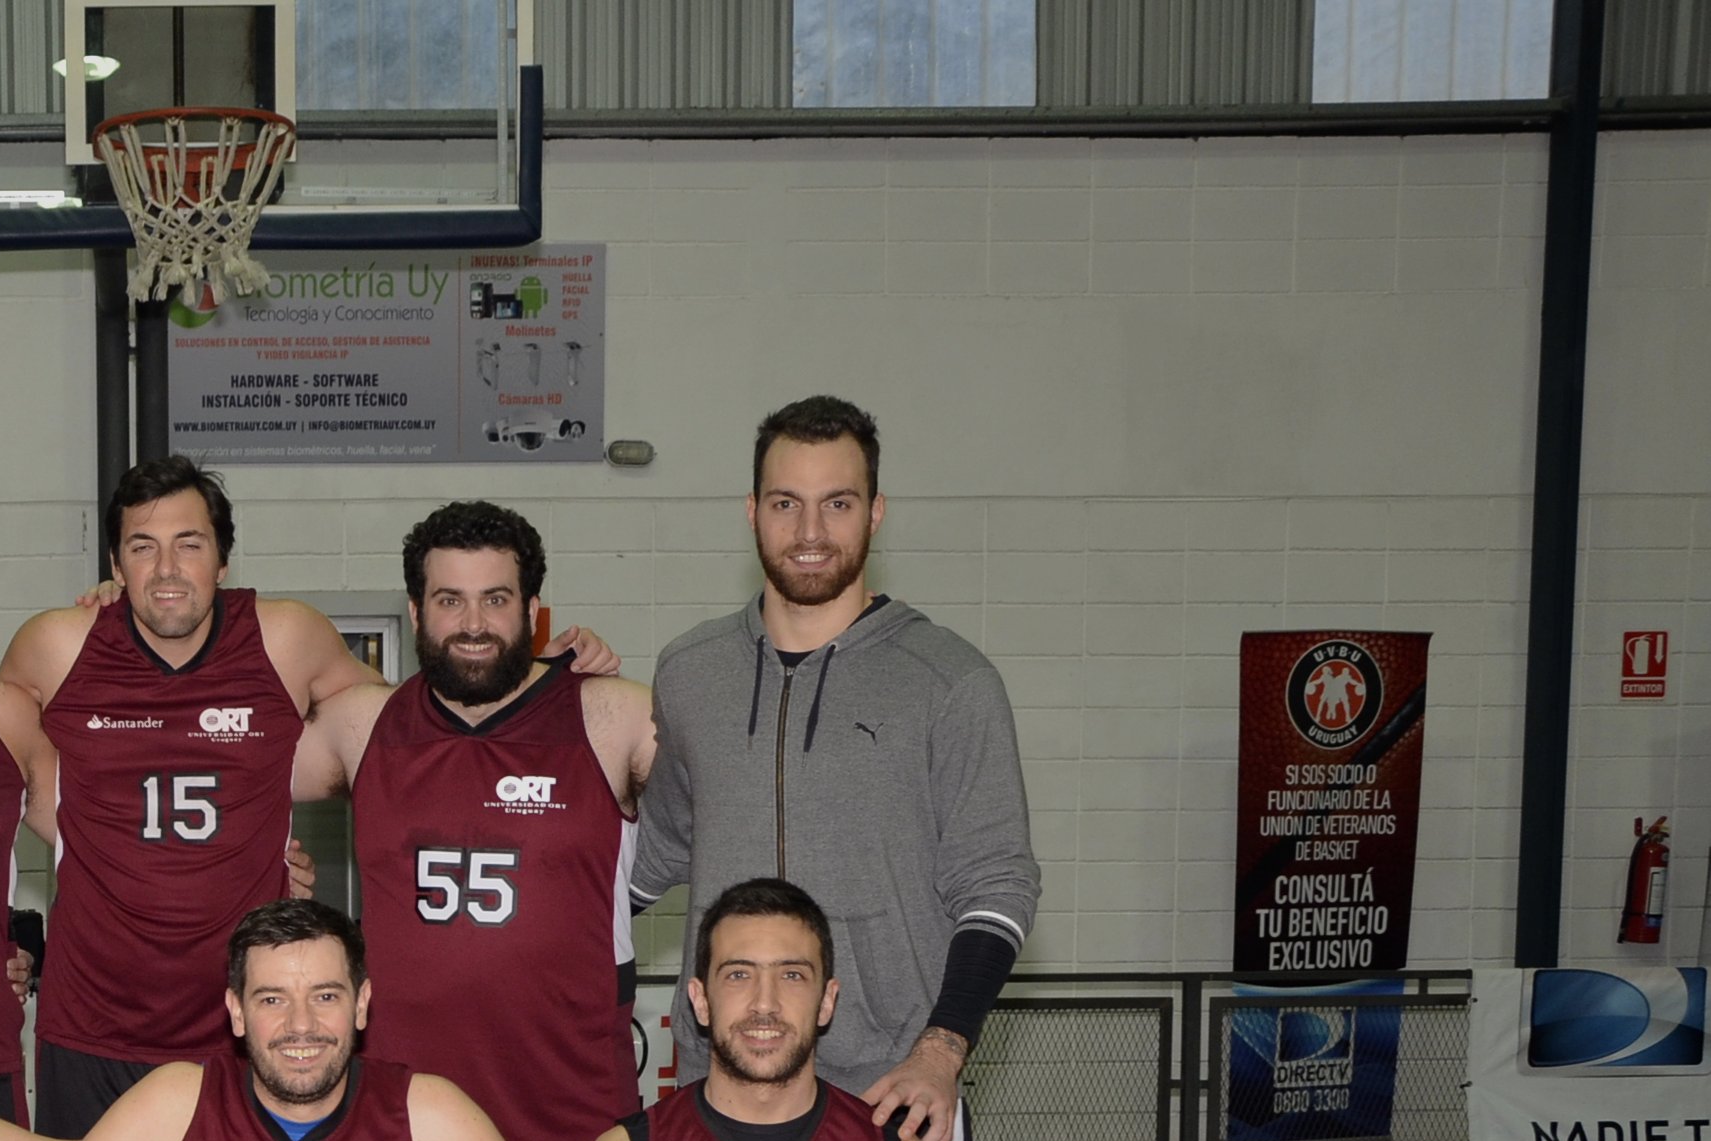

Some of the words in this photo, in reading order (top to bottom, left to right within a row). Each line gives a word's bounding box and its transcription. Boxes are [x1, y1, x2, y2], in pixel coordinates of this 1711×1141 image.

[524, 255, 579, 267] Terminales
[236, 261, 394, 299] ometría
[408, 263, 449, 305] Uy
[244, 304, 319, 326] Tecnología
[322, 308, 332, 324] y
[335, 304, 435, 323] Conocimiento
[175, 337, 226, 348] SOLUCIONES
[242, 337, 281, 347] CONTROL
[369, 336, 381, 346] DE
[383, 335, 431, 346] ASISTENCIA
[505, 325, 556, 337] Molinetes
[264, 350, 289, 360] VIDEO
[292, 350, 338, 360] VIGILANCIA
[230, 374, 300, 388] HARDWARE
[313, 373, 379, 387] SOFTWARE
[201, 391, 282, 408] INSTALACIÓN
[294, 393, 351, 407] SOPORTE
[354, 389, 408, 407] TÉCNICO
[547, 393, 562, 404] HD
[173, 420, 297, 432] WWW.BIOMETRIAUY.COM.UY
[308, 419, 436, 432] INFO@BIOMETRIAUY.COM.UY
[1622, 684, 1664, 694] EXTINTOR
[103, 716, 164, 729] Santander
[199, 707, 253, 733] ORT
[1308, 724, 1358, 744] URUGUAY
[1285, 764, 1299, 785] SI
[1301, 764, 1326, 784] SOS
[1327, 764, 1364, 784] SOCIO
[1366, 763, 1377, 784] O
[496, 775, 557, 803] ORT
[1267, 789, 1352, 811] FUNCIONARIO
[1353, 789, 1371, 809] DE
[1373, 789, 1391, 809] LA
[142, 775, 218, 841] 15
[1260, 810, 1304, 836] UNIÓN
[1306, 815, 1322, 836] DE
[1322, 814, 1397, 835] VETERANOS
[1295, 840, 1312, 861] DE
[1313, 839, 1360, 860] BASKET
[416, 847, 519, 926] 55
[1274, 866, 1375, 905] CONSULTÁ
[1255, 908, 1283, 938] TU
[1288, 905, 1389, 938] BENEFICIO
[1268, 938, 1373, 971] EXCLUSIVO
[1277, 1063, 1349, 1083] DIRECTV
